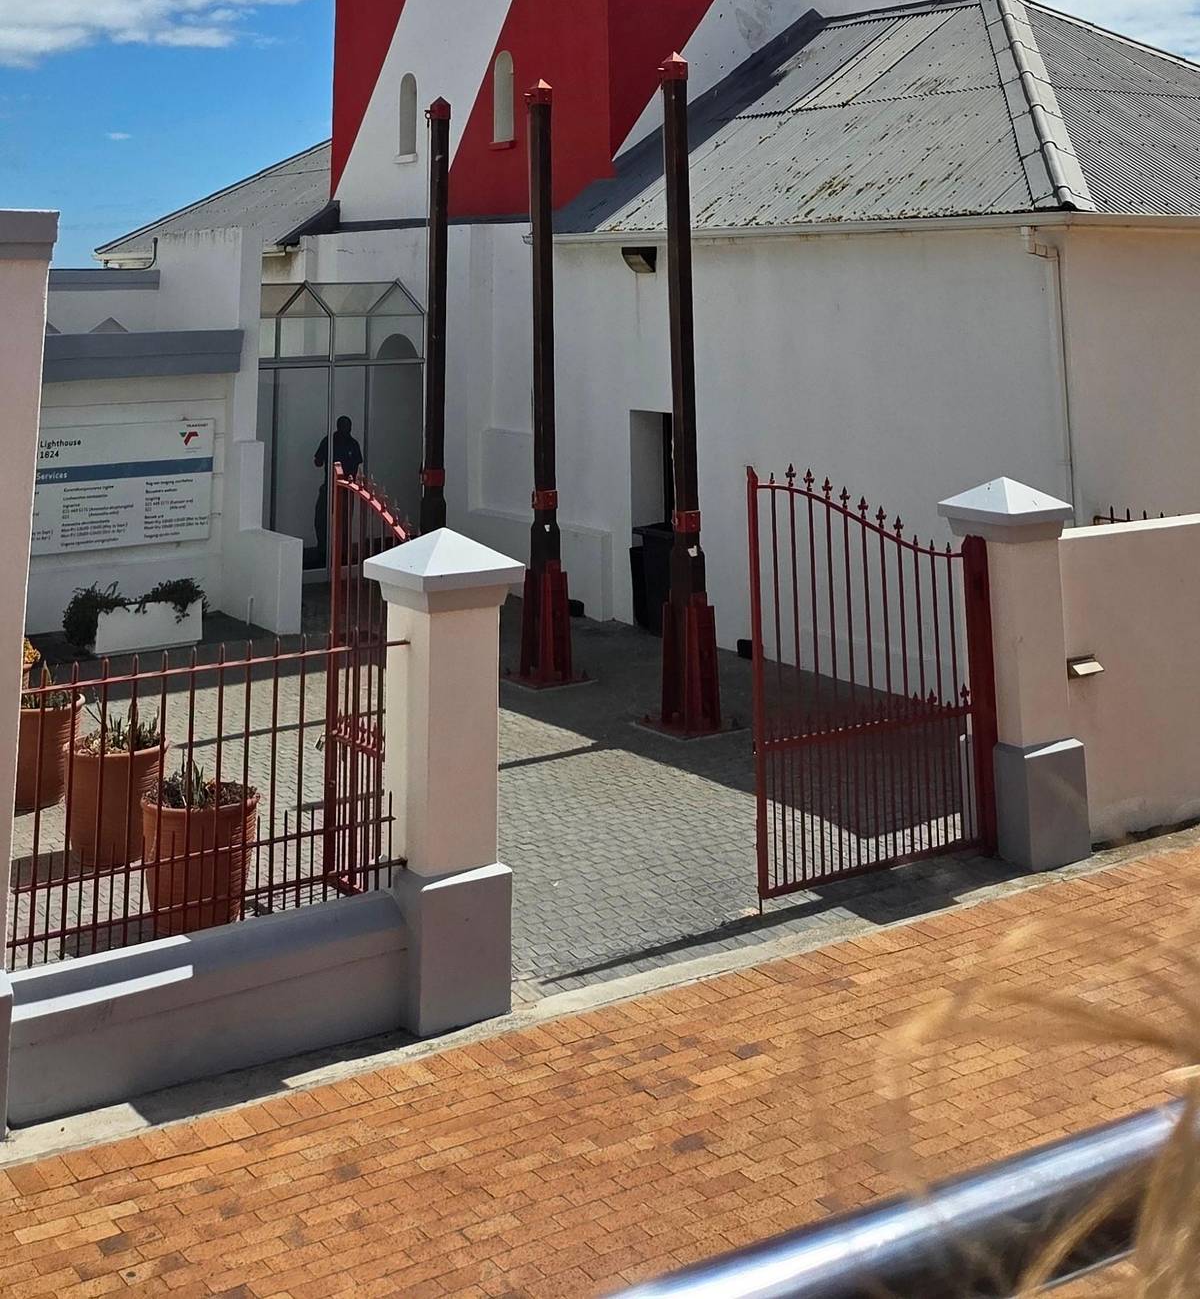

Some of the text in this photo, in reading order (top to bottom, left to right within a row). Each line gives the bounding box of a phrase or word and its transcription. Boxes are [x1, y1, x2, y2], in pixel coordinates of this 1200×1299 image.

[40, 439, 82, 449] Lighthouse
[40, 450, 59, 459] 1824
[37, 472, 68, 481] Services
